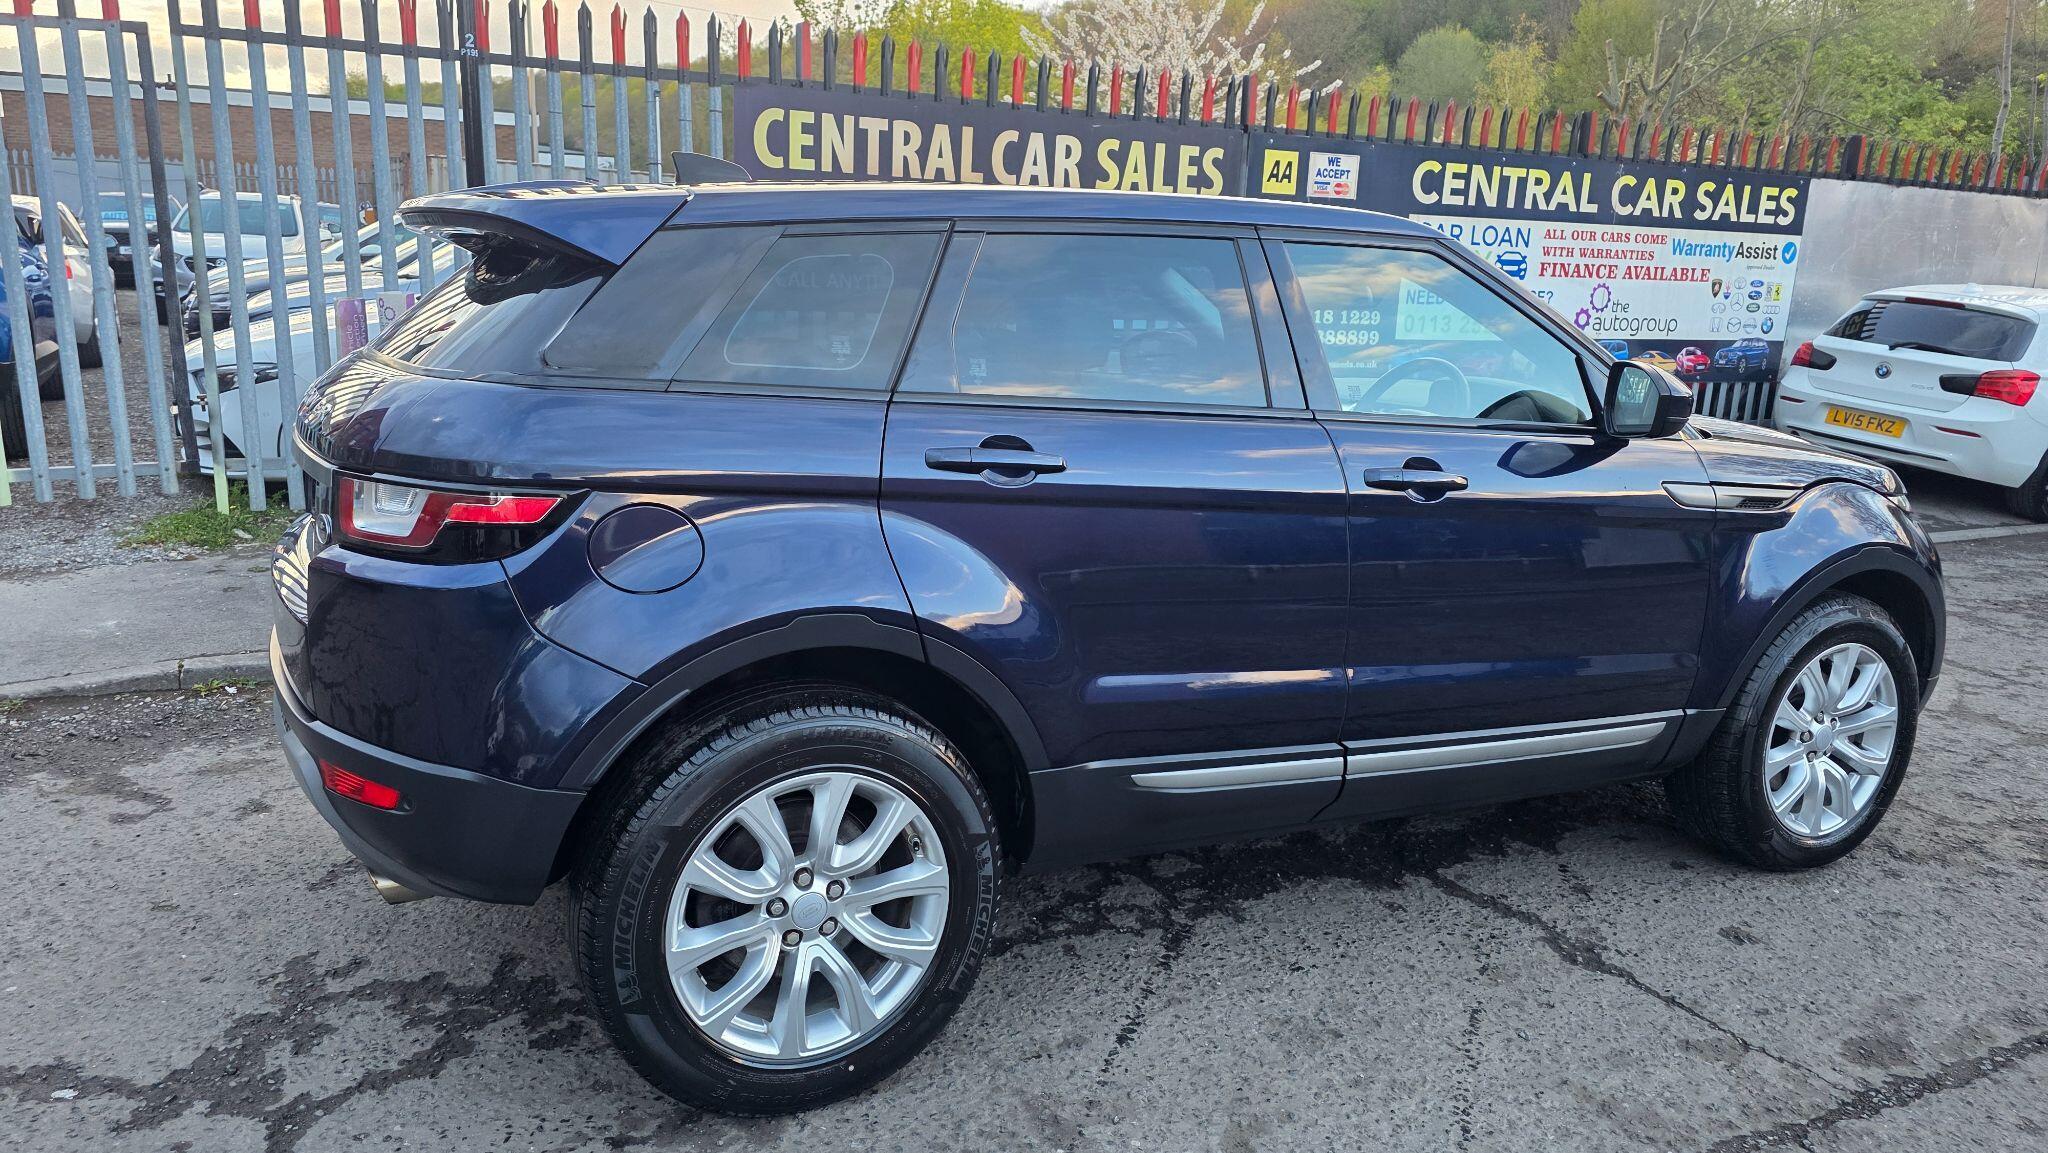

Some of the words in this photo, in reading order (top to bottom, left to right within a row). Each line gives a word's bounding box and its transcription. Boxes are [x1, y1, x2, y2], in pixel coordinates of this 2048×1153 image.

[464, 33, 475, 48] 2
[753, 107, 984, 184] CENTRAL
[991, 129, 1082, 188] CAR
[1095, 138, 1225, 197] SALES
[1327, 156, 1342, 167] WE
[1266, 159, 1293, 184] AA
[1315, 167, 1351, 180] ACCEPT
[1412, 160, 1599, 214] CENTRAL
[1611, 174, 1686, 219] CAR
[1693, 181, 1799, 226] SALES
[1470, 224, 1531, 249] LOAN
[1543, 229, 1567, 241] ALL
[1571, 229, 1597, 242] OUR
[1600, 231, 1631, 243] CARS
[1634, 233, 1668, 245] COME
[1542, 246, 1575, 258] WITH
[1579, 247, 1655, 261] WARRANTIES
[1538, 262, 1618, 279] FINANCE
[1622, 265, 1711, 282] AVAILABLE
[1611, 299, 1630, 313] the
[1340, 310, 1381, 325] 1229
[1592, 314, 1678, 337] autogroup
[1833, 409, 1865, 427] LV15
[1866, 417, 1896, 433] FKZ
